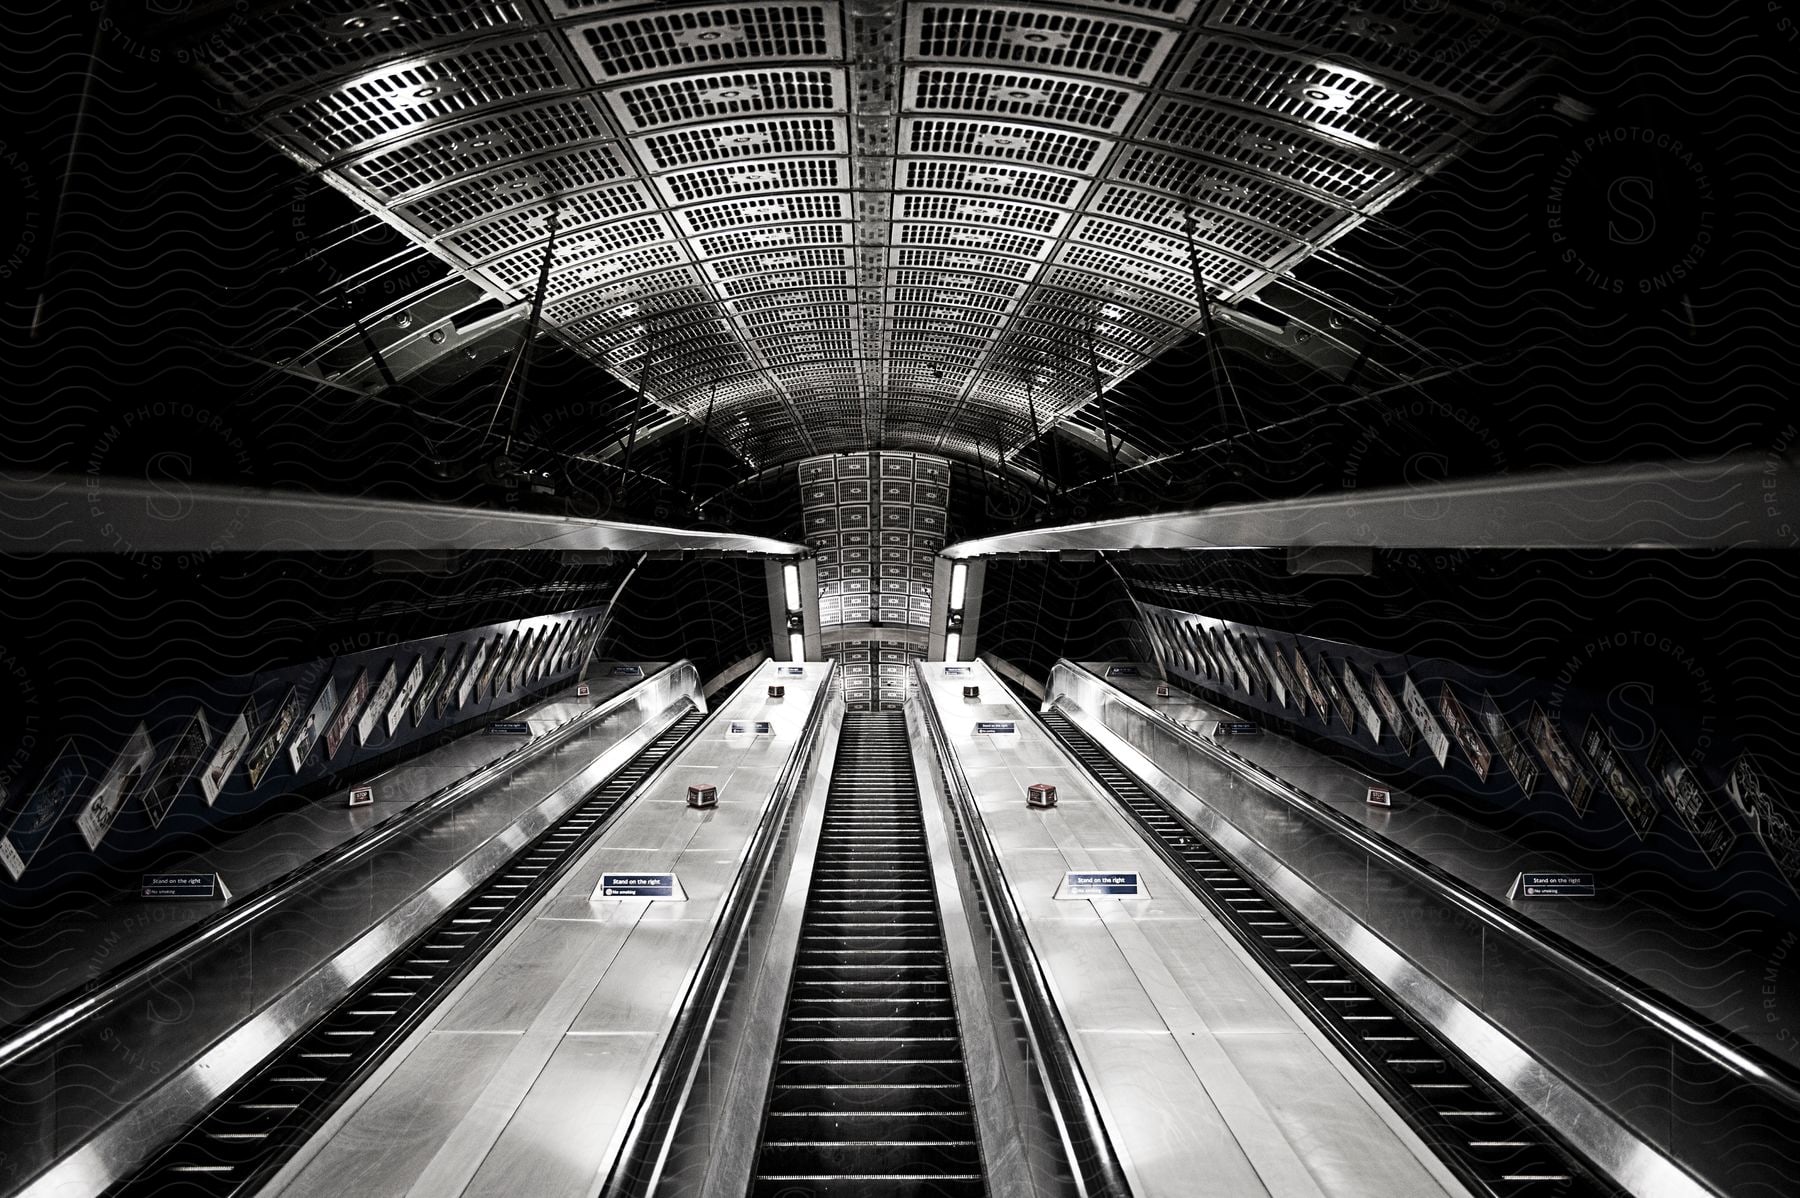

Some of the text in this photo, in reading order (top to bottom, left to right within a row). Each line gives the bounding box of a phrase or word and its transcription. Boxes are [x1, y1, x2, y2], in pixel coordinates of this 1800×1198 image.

[188, 878, 200, 886] right
[648, 878, 661, 886] right
[1112, 878, 1126, 886] right
[1568, 878, 1581, 886] right
